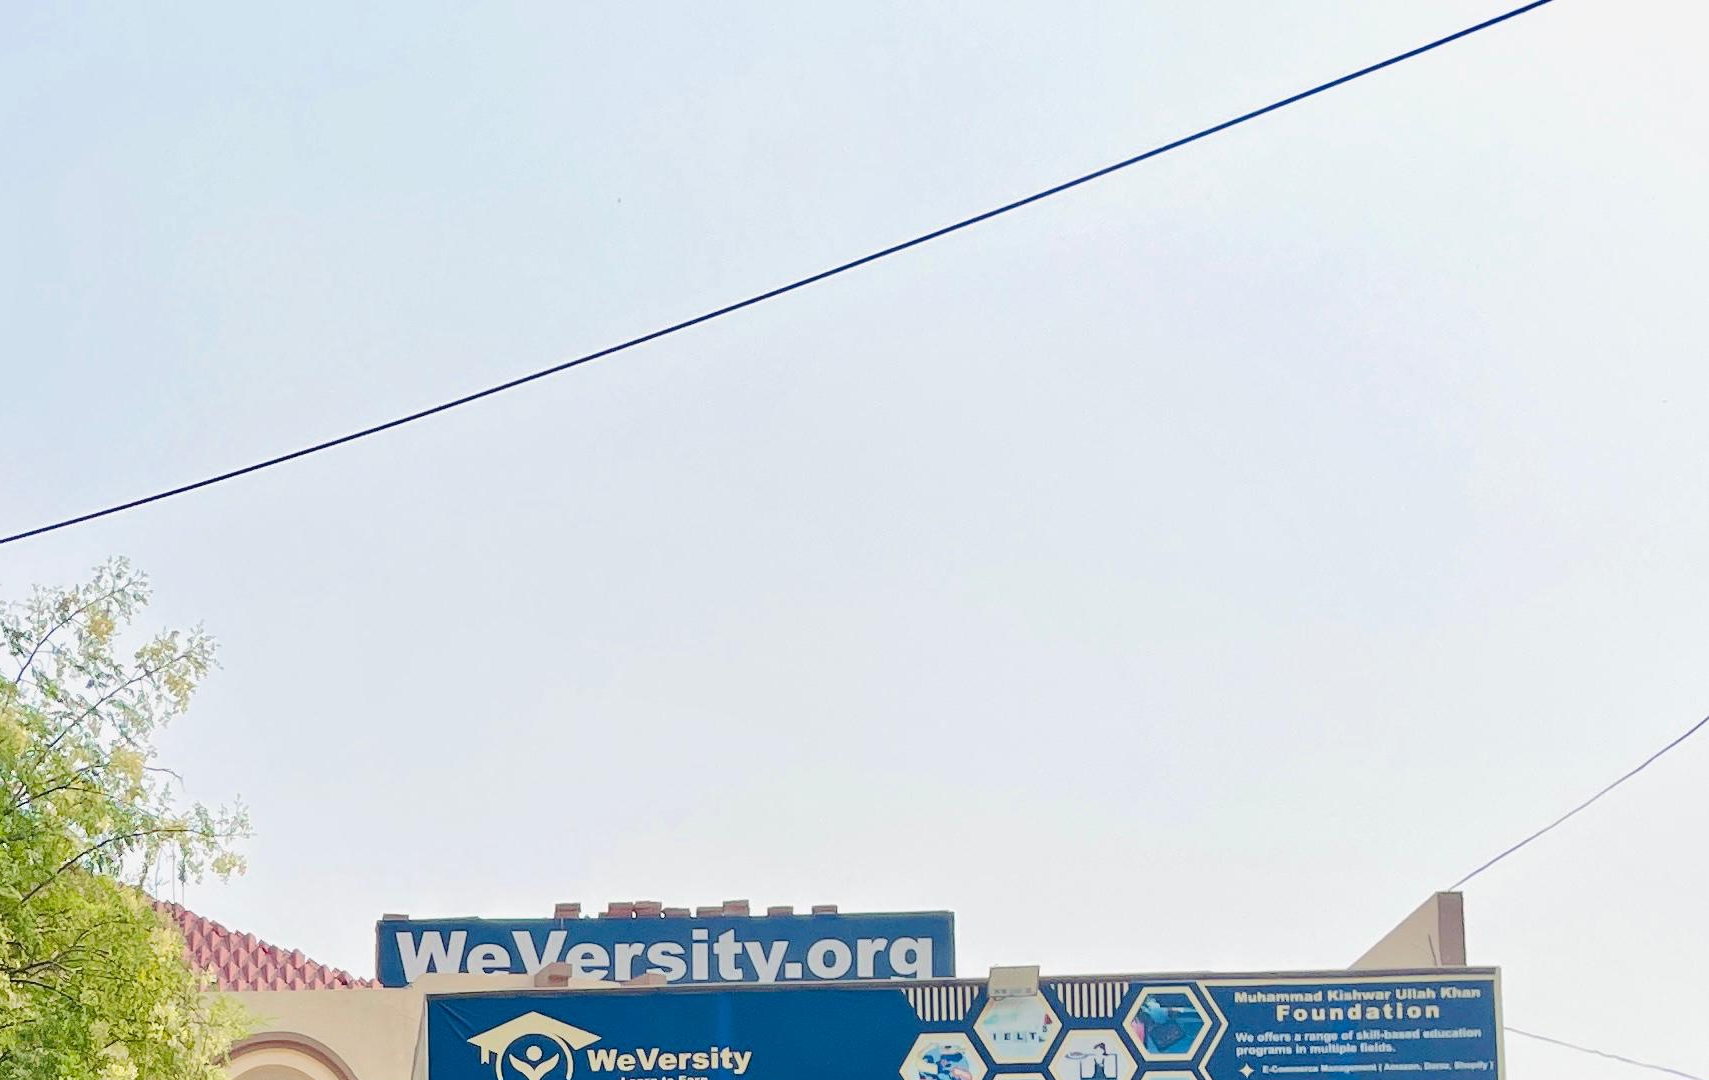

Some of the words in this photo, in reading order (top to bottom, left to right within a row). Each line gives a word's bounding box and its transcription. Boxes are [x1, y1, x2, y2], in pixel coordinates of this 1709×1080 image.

[396, 927, 934, 984] WeVersity.org
[1235, 991, 1322, 1003] Muhammad
[1328, 990, 1390, 1001] Kishwar
[1396, 988, 1435, 1000] Ullah
[1441, 987, 1481, 999] Khan
[1276, 1003, 1440, 1022] Foundation
[1235, 1032, 1254, 1042] We
[1257, 1031, 1290, 1042] offers
[1295, 1033, 1301, 1041] a
[1304, 1032, 1338, 1043] range
[1341, 1030, 1353, 1040] of
[1356, 1029, 1420, 1040] skill-based
[1423, 1028, 1481, 1039] education
[1236, 1045, 1292, 1057] programs
[1296, 1044, 1307, 1054] in
[1310, 1043, 1357, 1055] multiple
[587, 1046, 752, 1075] WeVersity
